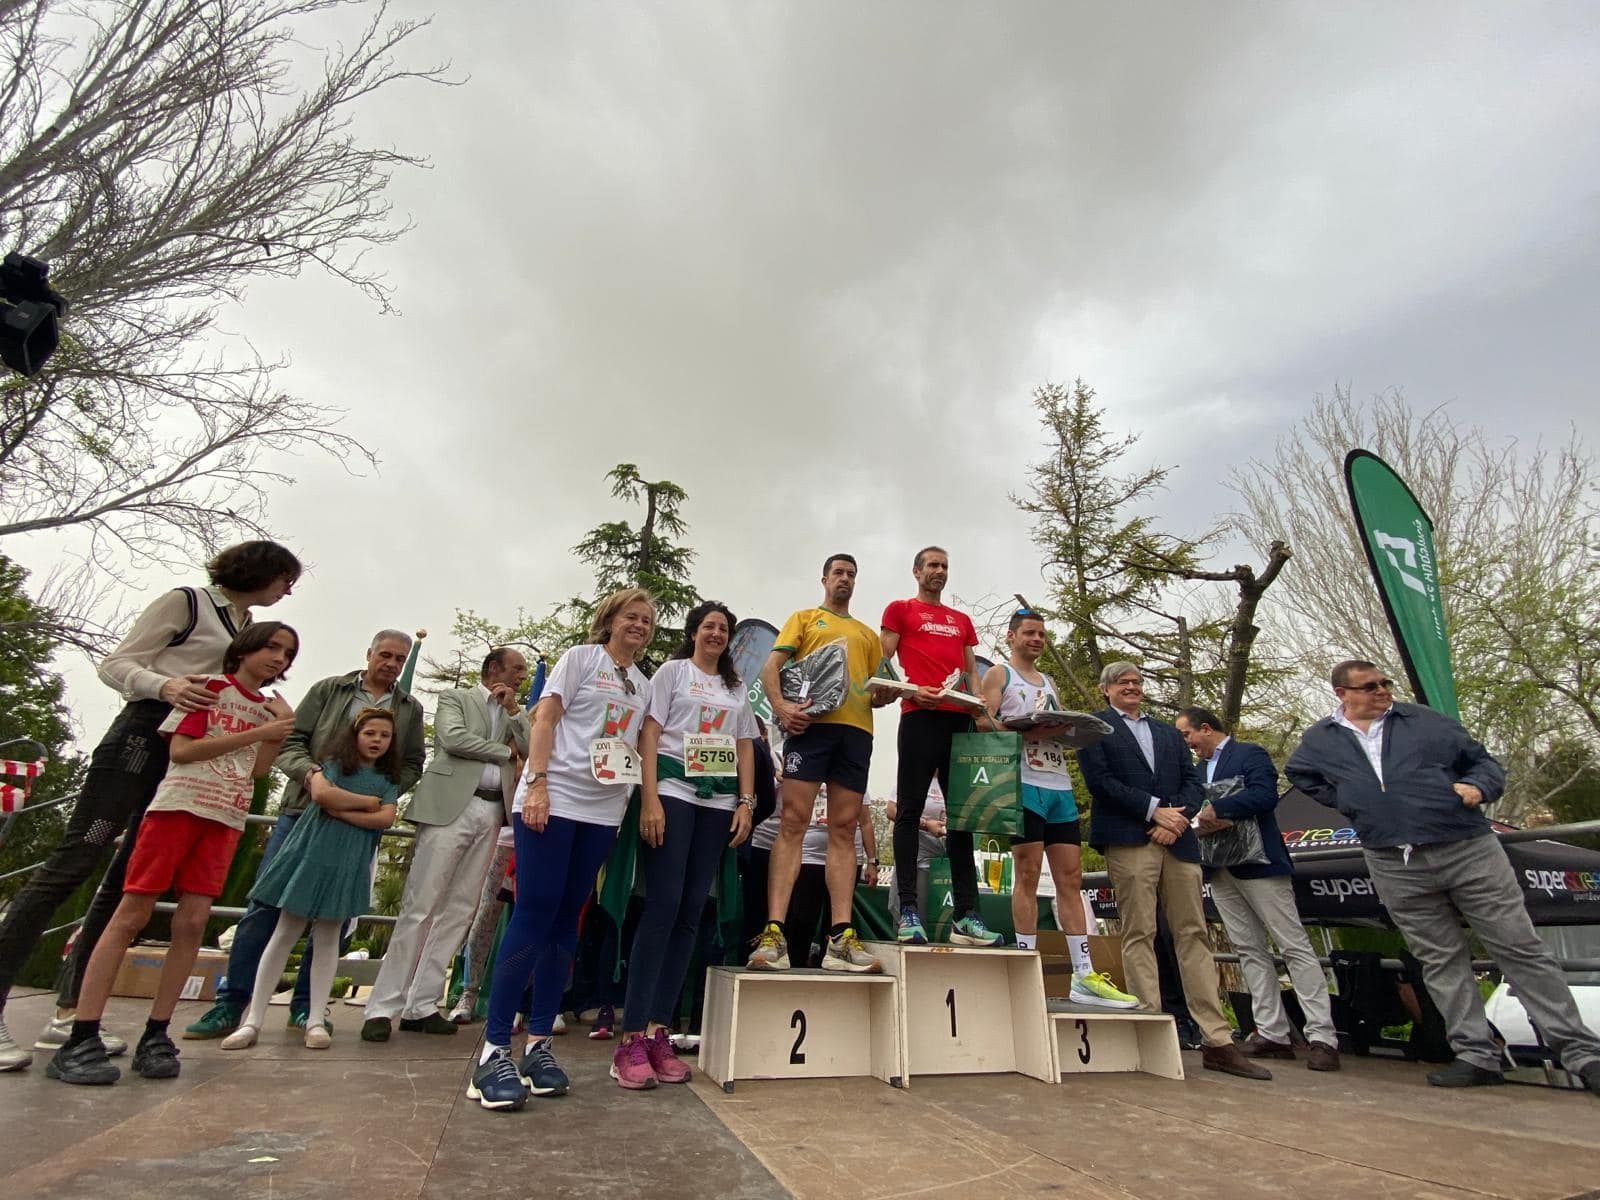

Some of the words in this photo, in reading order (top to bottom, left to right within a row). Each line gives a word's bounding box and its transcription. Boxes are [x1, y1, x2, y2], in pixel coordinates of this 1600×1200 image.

[624, 755, 632, 769] 2
[700, 750, 735, 763] 5750
[1043, 751, 1062, 767] 184
[1310, 878, 1374, 903] super
[945, 988, 957, 1038] 1
[790, 1009, 807, 1065] 2
[1075, 1018, 1091, 1065] 3
